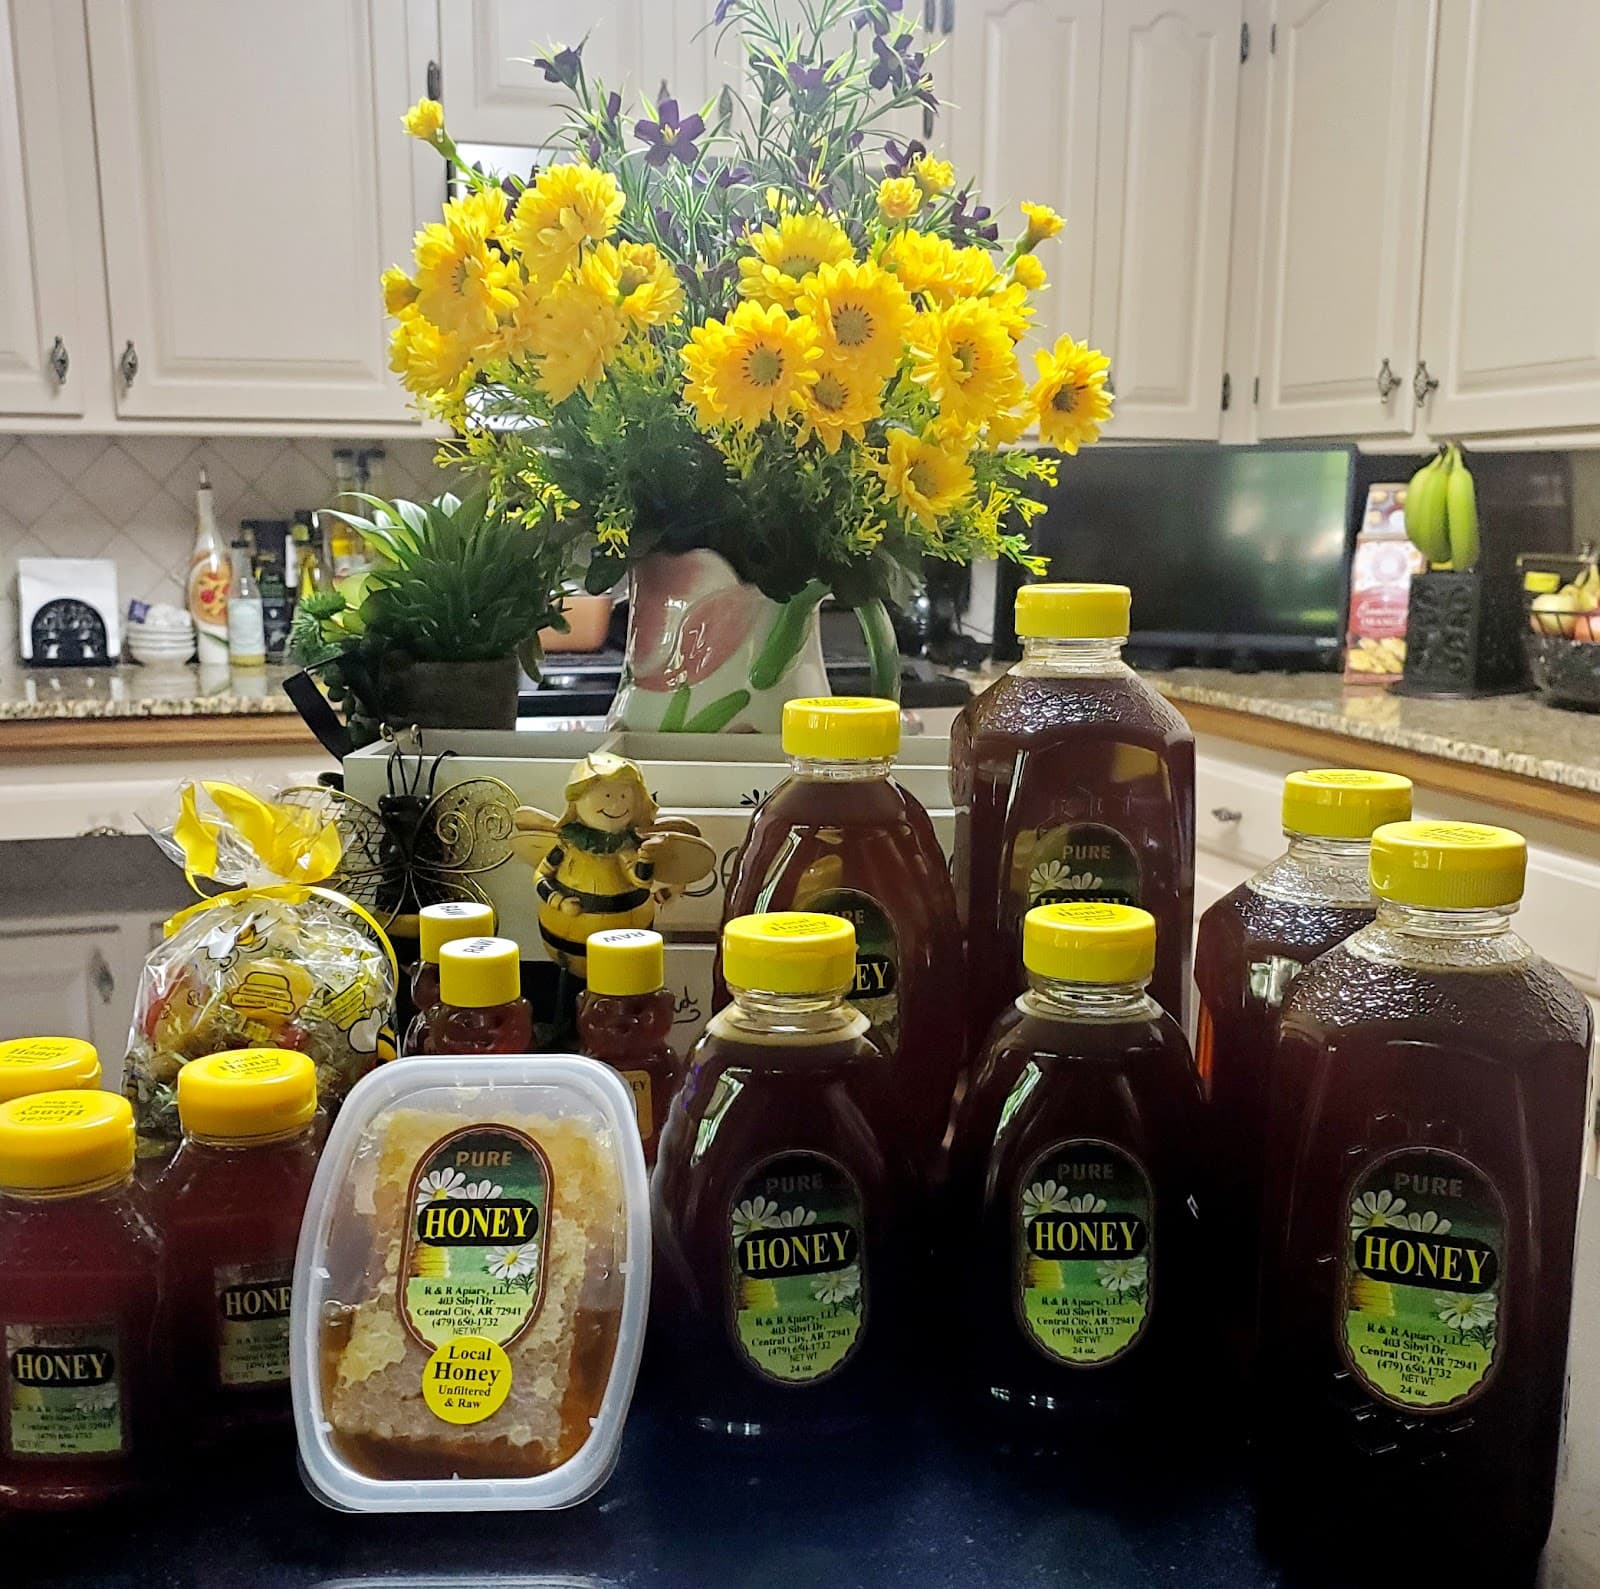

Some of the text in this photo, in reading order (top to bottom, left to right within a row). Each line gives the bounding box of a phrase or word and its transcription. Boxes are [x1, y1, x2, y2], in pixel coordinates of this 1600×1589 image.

[1063, 845, 1111, 860] PURE
[769, 920, 828, 932] Honey
[603, 931, 646, 943] RAW
[463, 939, 496, 954] RAW
[218, 1057, 281, 1071] Honey
[223, 1054, 265, 1064] Local
[14, 1109, 87, 1117] Honey
[456, 1151, 513, 1167] PURE
[1057, 1163, 1114, 1180] PURE
[766, 1172, 823, 1194] PURE
[1394, 1172, 1463, 1198] PURE
[423, 1207, 534, 1239] HONEY
[1034, 1221, 1140, 1252] HONEY
[744, 1229, 850, 1272] HONEY
[1361, 1235, 1491, 1285] HONEY
[424, 1286, 432, 1295] R
[434, 1286, 442, 1295] &
[446, 1286, 453, 1295] R
[225, 1286, 292, 1316] HONE
[438, 1297, 496, 1308] 403 Sibyl Dr.
[417, 1307, 521, 1318] Central City, AR 72941
[432, 1318, 499, 1328] (479) 650-1732
[1037, 1317, 1069, 1326] Central
[1093, 1317, 1108, 1325] AR
[453, 1327, 469, 1335] NET
[1052, 1327, 1074, 1336] (479)
[1367, 1323, 1375, 1333] R
[1377, 1325, 1386, 1334] &
[1391, 1326, 1400, 1336] R
[752, 1336, 785, 1346] Central
[810, 1331, 824, 1341] AR
[1073, 1336, 1088, 1344] NET
[448, 1346, 492, 1361] Local
[1383, 1338, 1448, 1356] 403 Sibyl Dr.
[1360, 1345, 1477, 1371] Central City, AR 72941
[16, 1353, 107, 1380] HONEY
[790, 1365, 800, 1373] 24
[1377, 1359, 1452, 1379] (479) 650-1732
[433, 1361, 501, 1387] Honey
[1401, 1373, 1420, 1384] NET
[438, 1384, 491, 1397] Unfiltered
[1400, 1385, 1412, 1395] 24
[444, 1398, 481, 1409] & Raw
